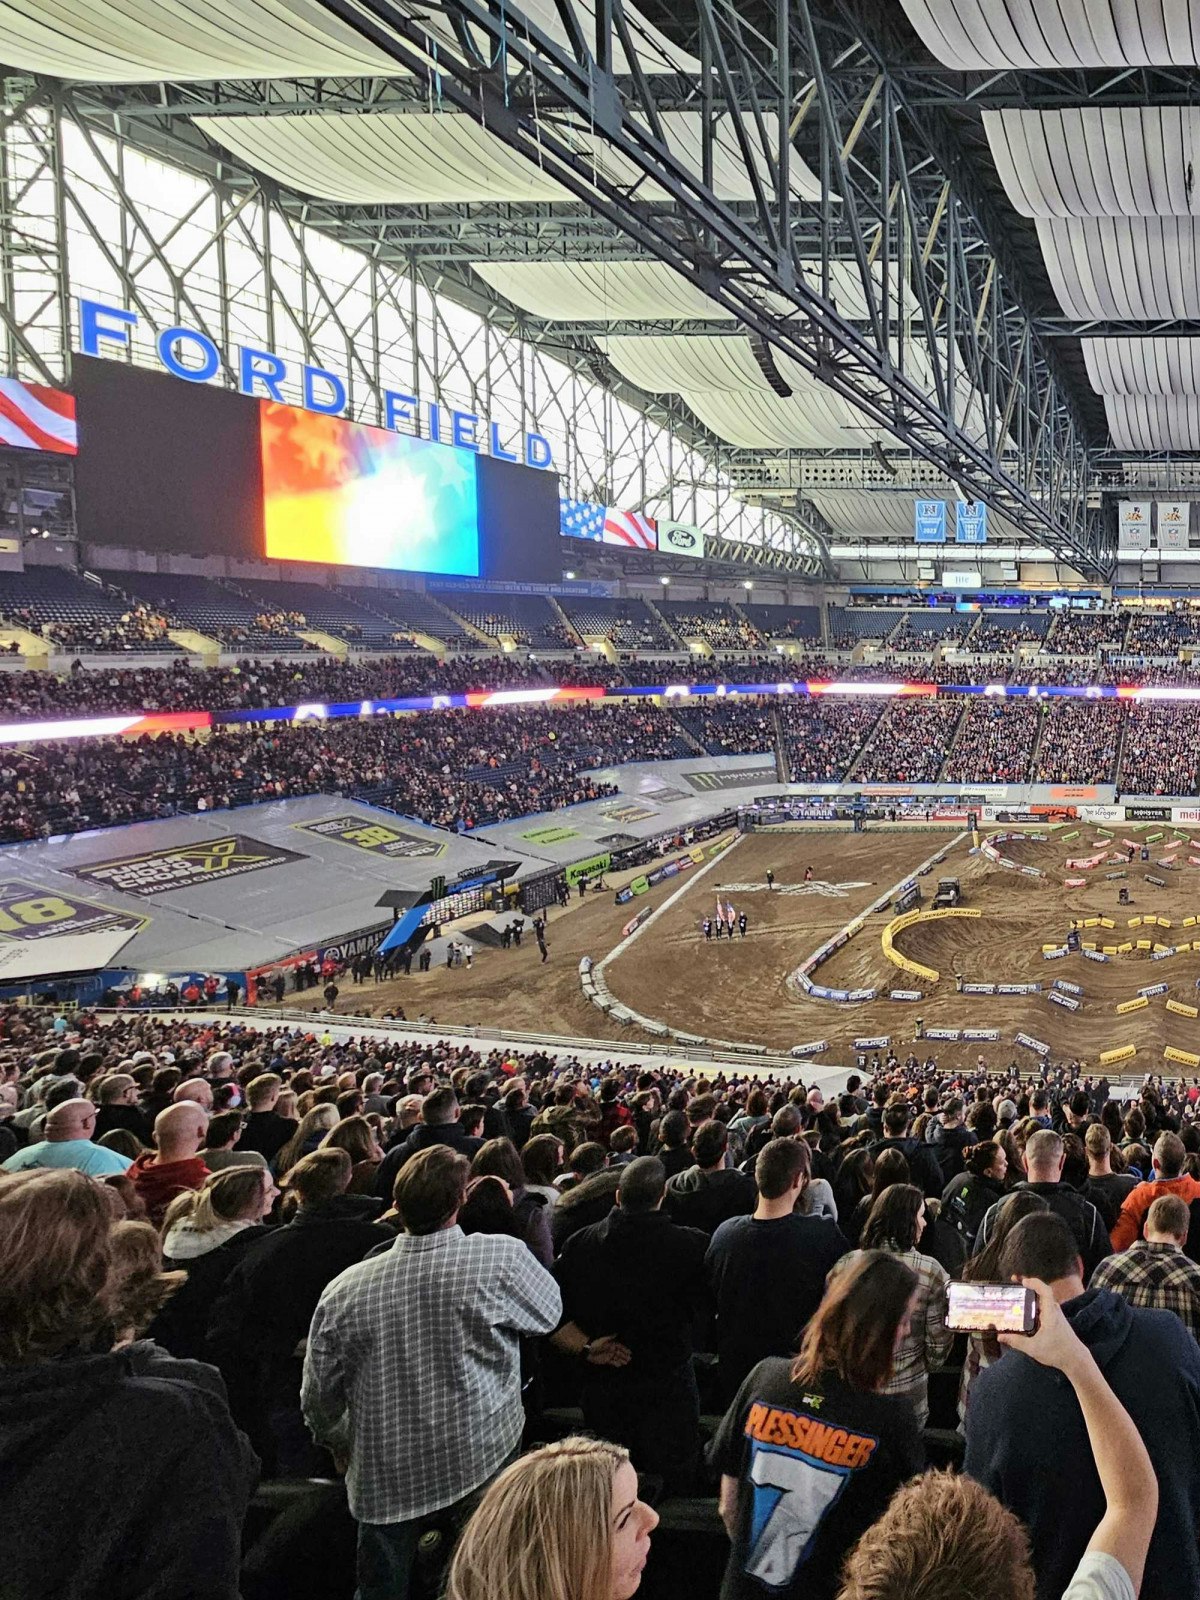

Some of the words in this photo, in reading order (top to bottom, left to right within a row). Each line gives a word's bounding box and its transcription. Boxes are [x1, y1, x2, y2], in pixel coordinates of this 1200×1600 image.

[79, 299, 347, 416] FORD
[383, 389, 553, 471] FIELD
[670, 530, 693, 548] Ford
[800, 809, 832, 817] YAMAHA
[341, 826, 401, 848] 38
[113, 860, 193, 882] MOTO
[119, 865, 206, 889] CROSS
[139, 878, 193, 894] WORLD
[193, 856, 288, 883] CHAMPIONSHIP
[570, 859, 607, 880] Kawasaki
[926, 1032, 959, 1040] FALKEN
[964, 1032, 996, 1040] FALKEN
[793, 1044, 824, 1055] FALKEN
[745, 1402, 877, 1469] PLESSINGER
[745, 1445, 850, 1589] 7
